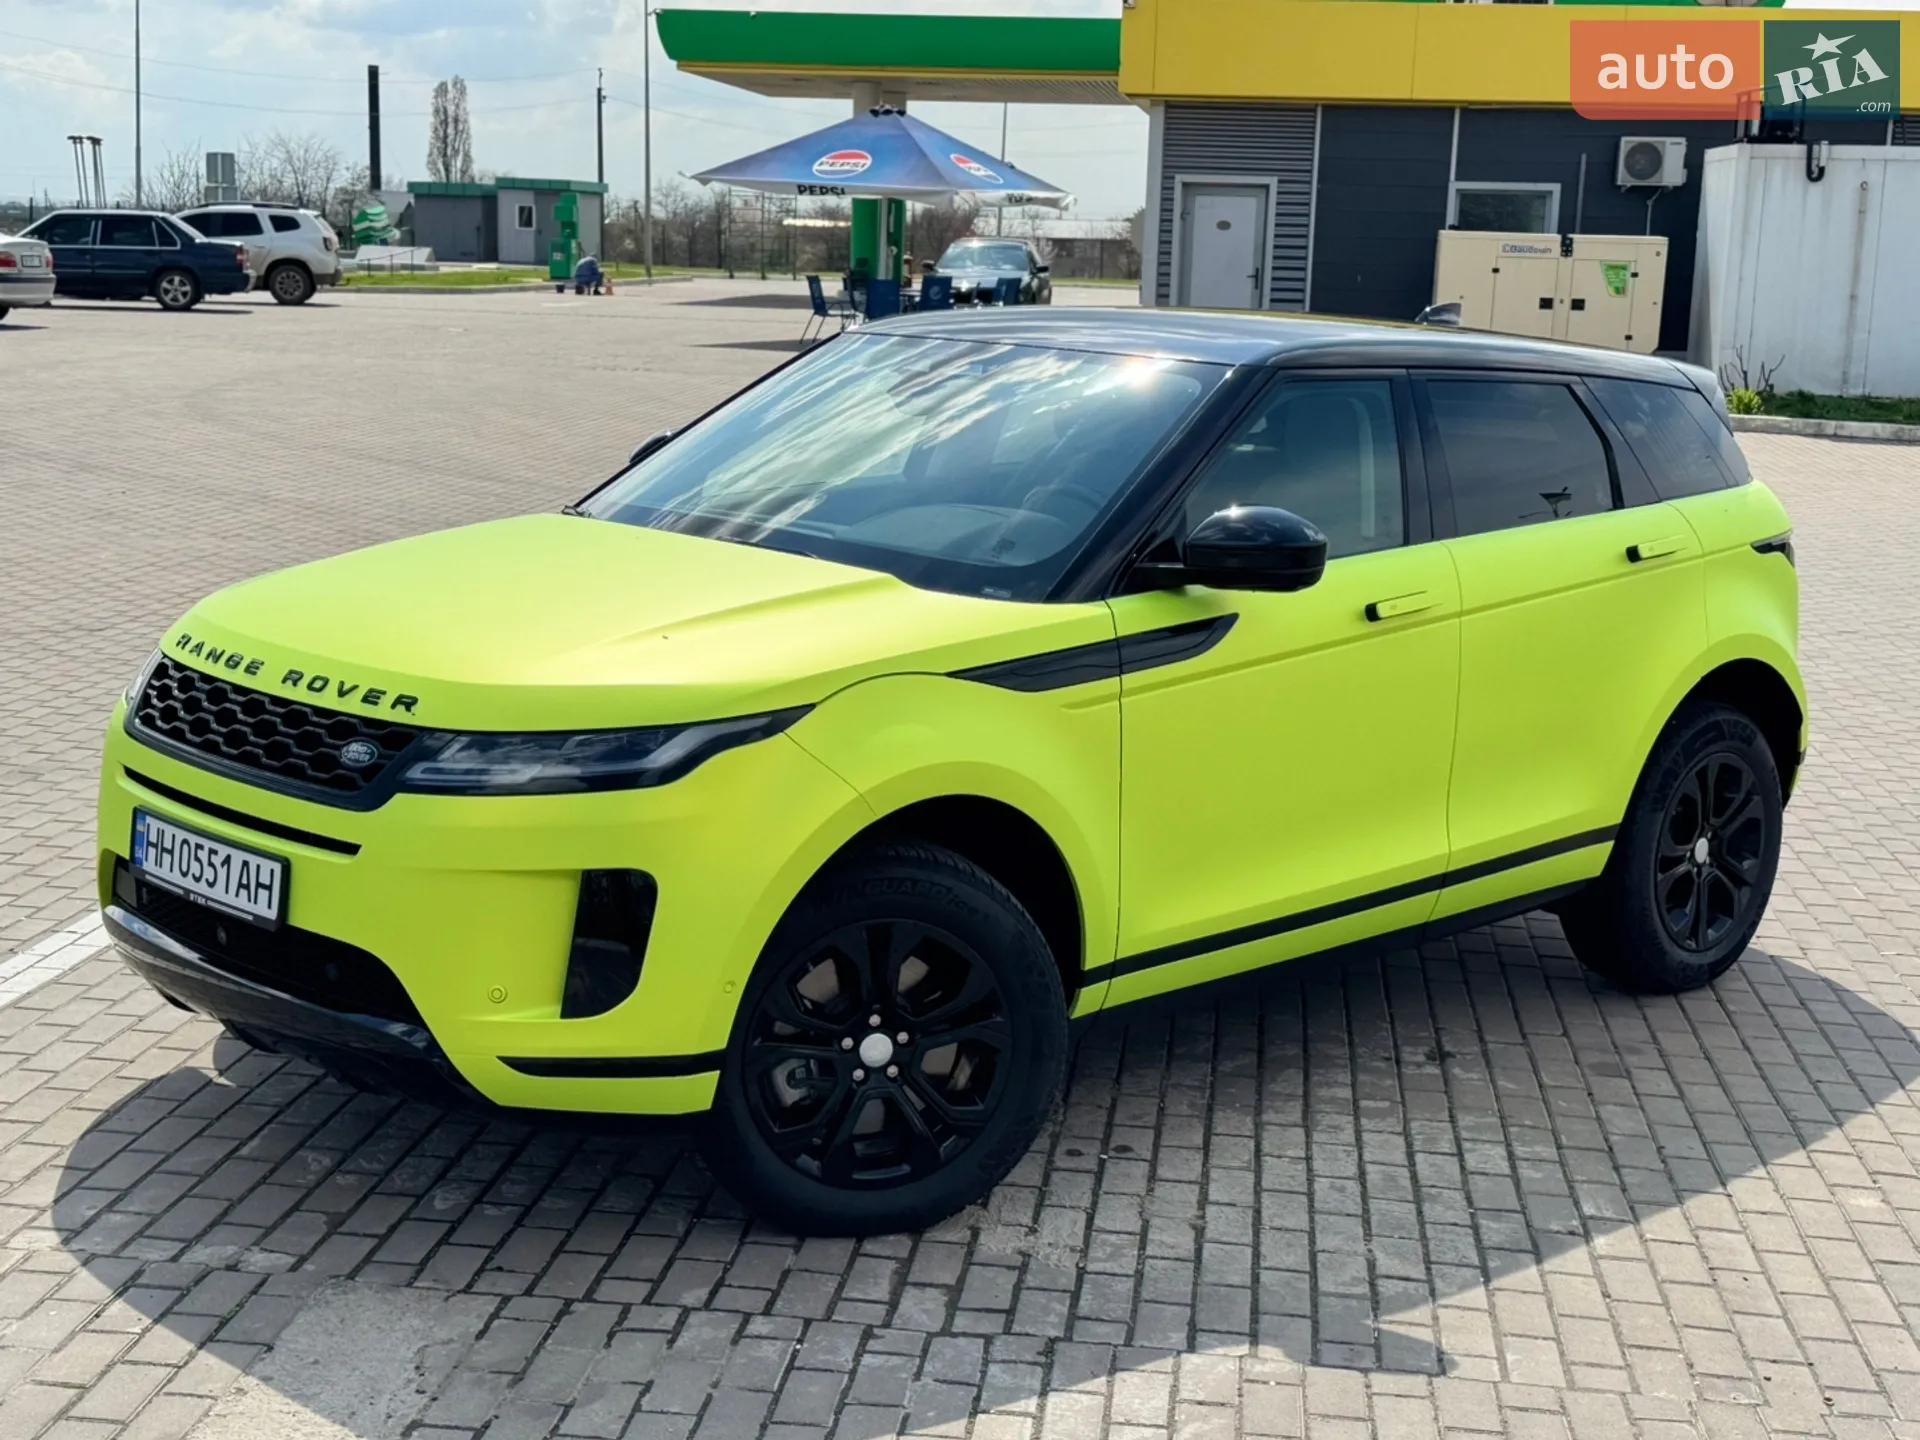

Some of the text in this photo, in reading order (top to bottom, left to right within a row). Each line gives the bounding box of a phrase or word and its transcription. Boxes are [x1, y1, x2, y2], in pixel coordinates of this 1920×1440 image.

[817, 161, 868, 169] PEPSI
[796, 184, 846, 197] PEPSI
[176, 633, 419, 713] RANGE ROVER
